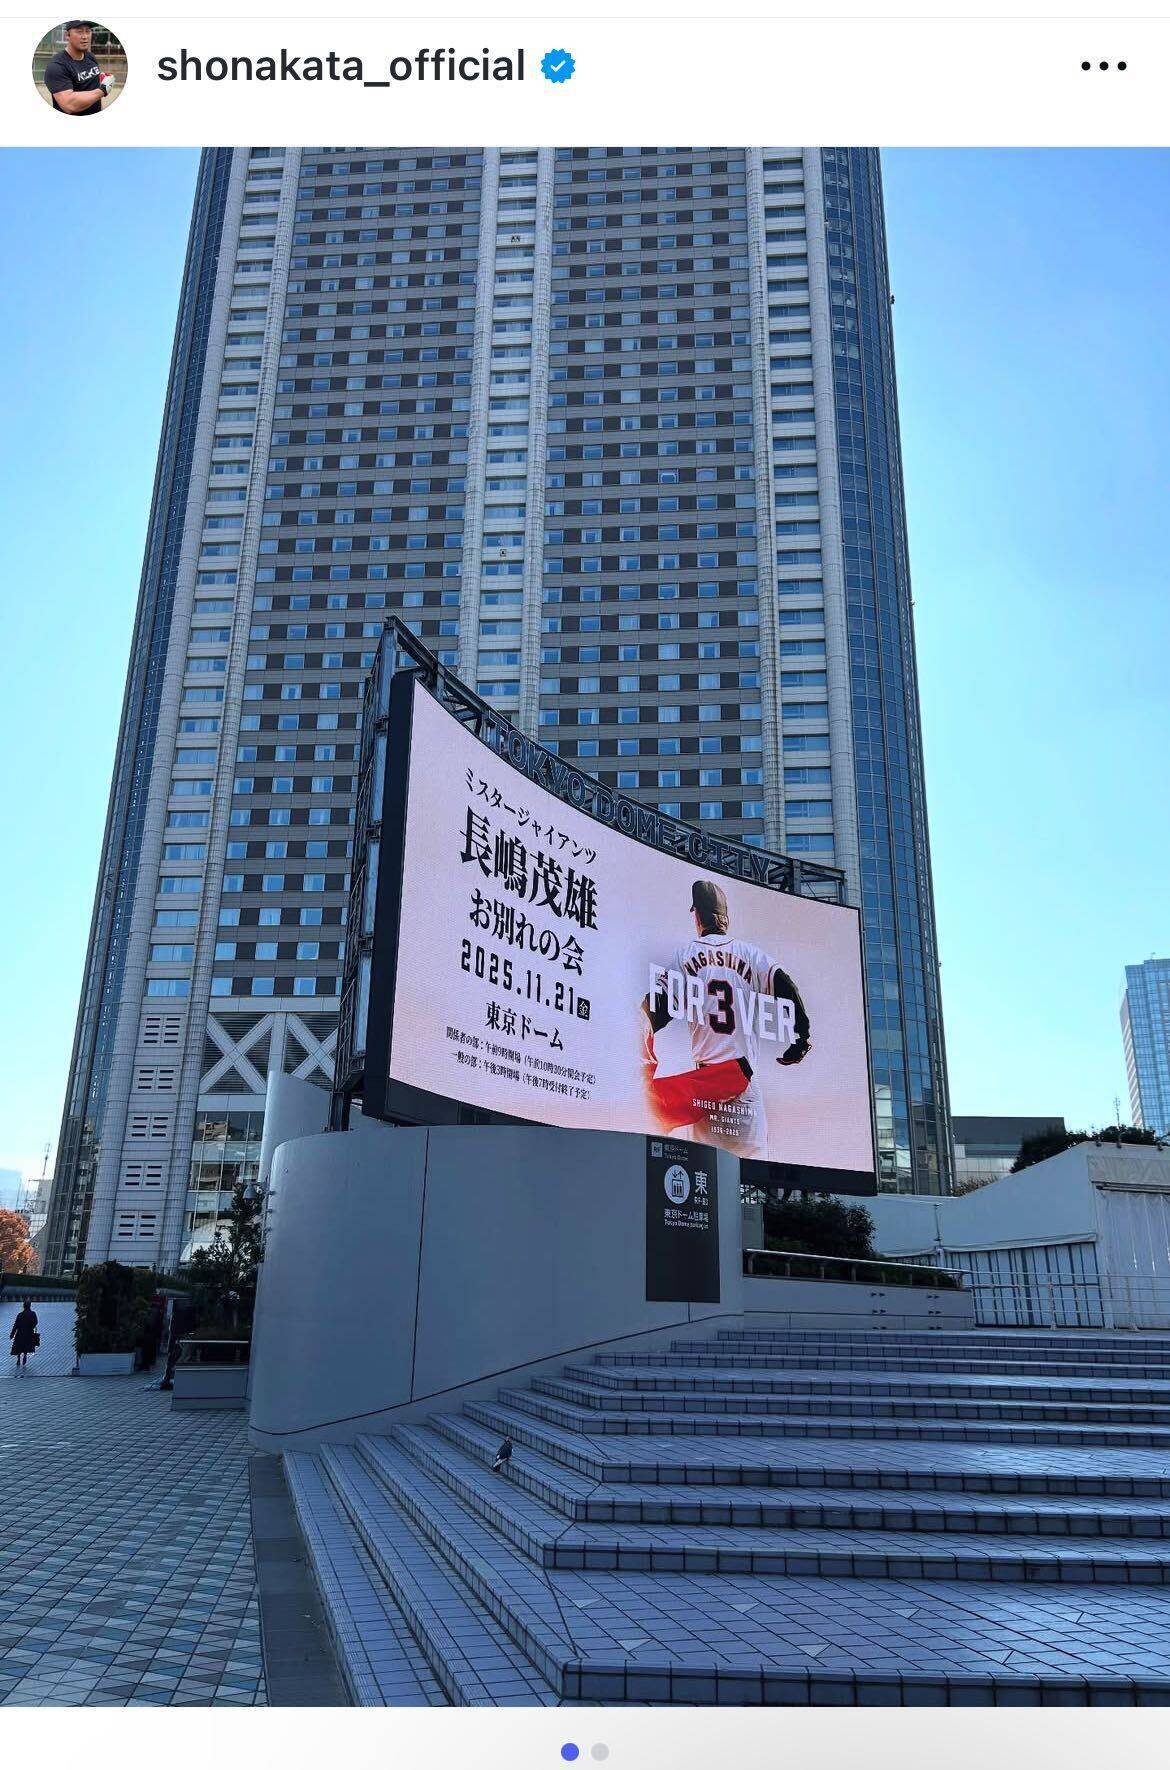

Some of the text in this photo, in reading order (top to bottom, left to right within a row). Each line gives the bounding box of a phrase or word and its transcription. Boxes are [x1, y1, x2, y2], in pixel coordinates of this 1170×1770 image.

[464, 767, 598, 865] ミスタージャイアンツ
[488, 709, 771, 885] TOKYO DOME CITY
[460, 805, 599, 931] 長嶋茂雄
[469, 887, 585, 977] お別れの会
[484, 1000, 564, 1052] 東京ドーム
[692, 1098, 716, 1111] SHIGEO
[694, 1170, 708, 1195] 東
